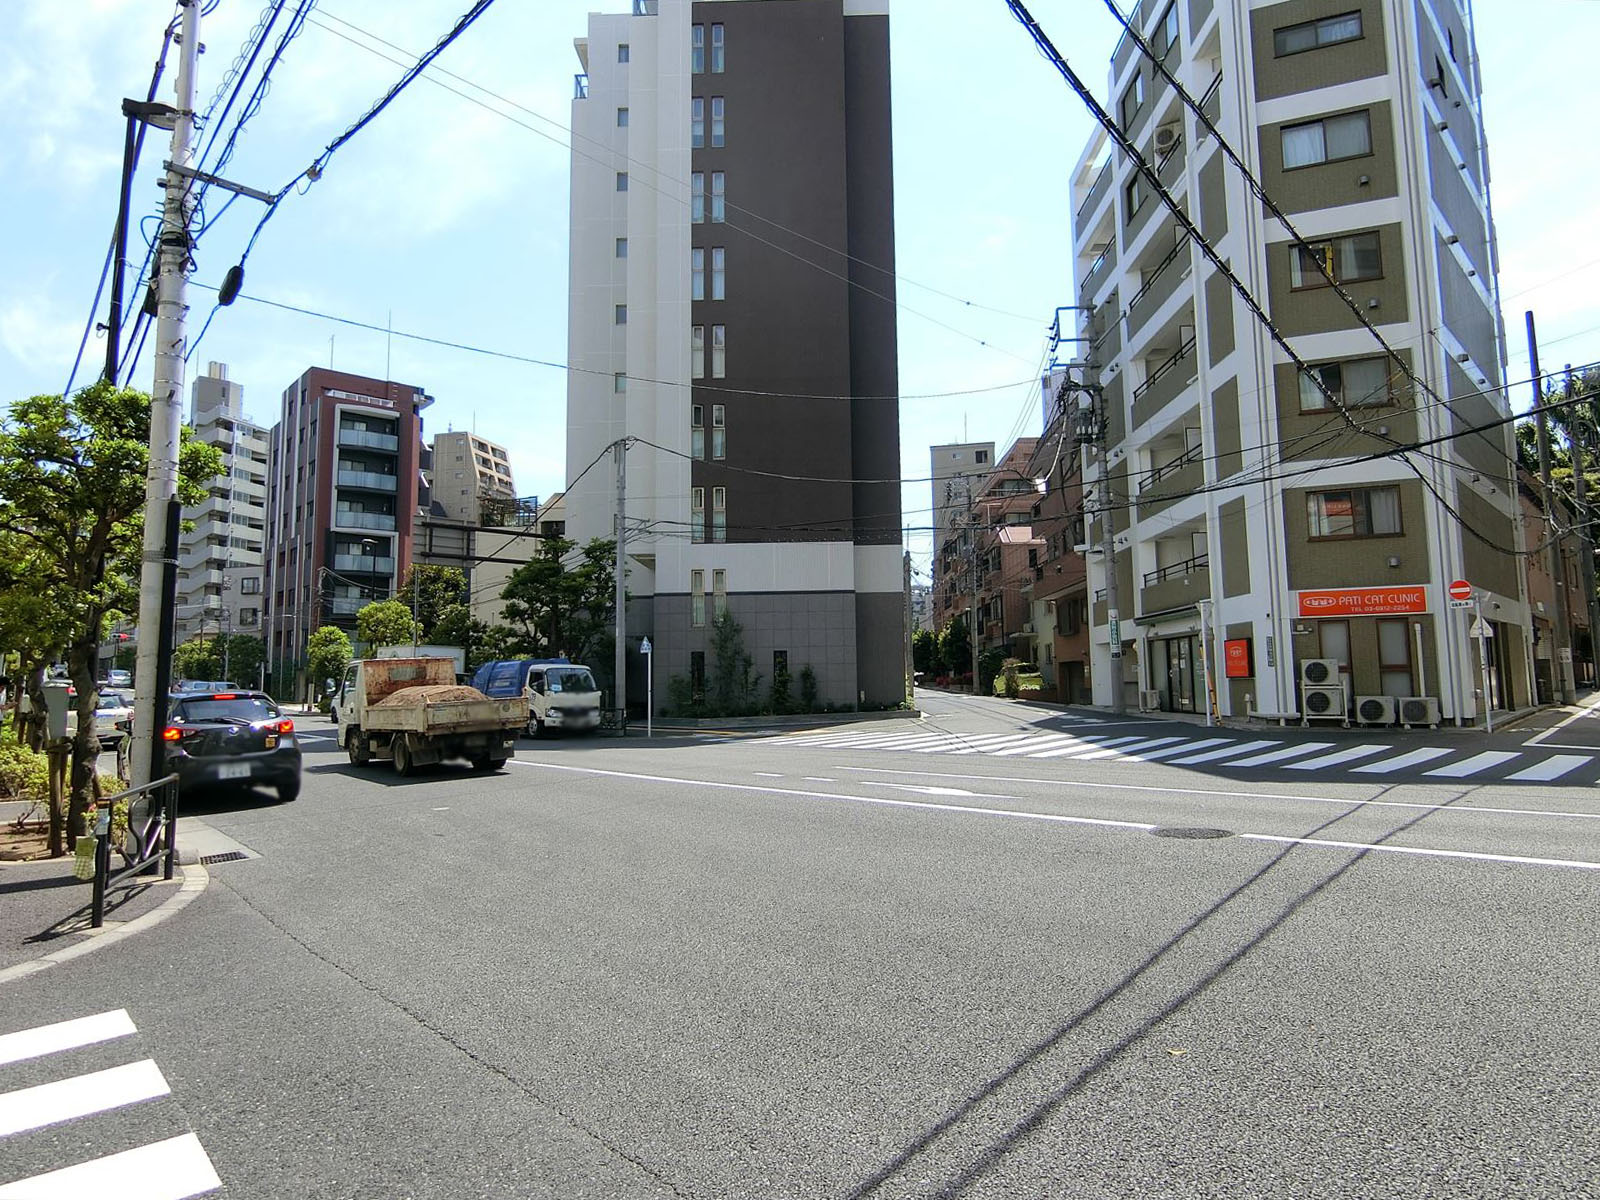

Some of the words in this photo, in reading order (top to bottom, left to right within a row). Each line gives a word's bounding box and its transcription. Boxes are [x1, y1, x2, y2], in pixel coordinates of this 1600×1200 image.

[1339, 596, 1361, 606] PATI
[1364, 595, 1384, 605] CAT
[1387, 593, 1421, 604] CLINIC
